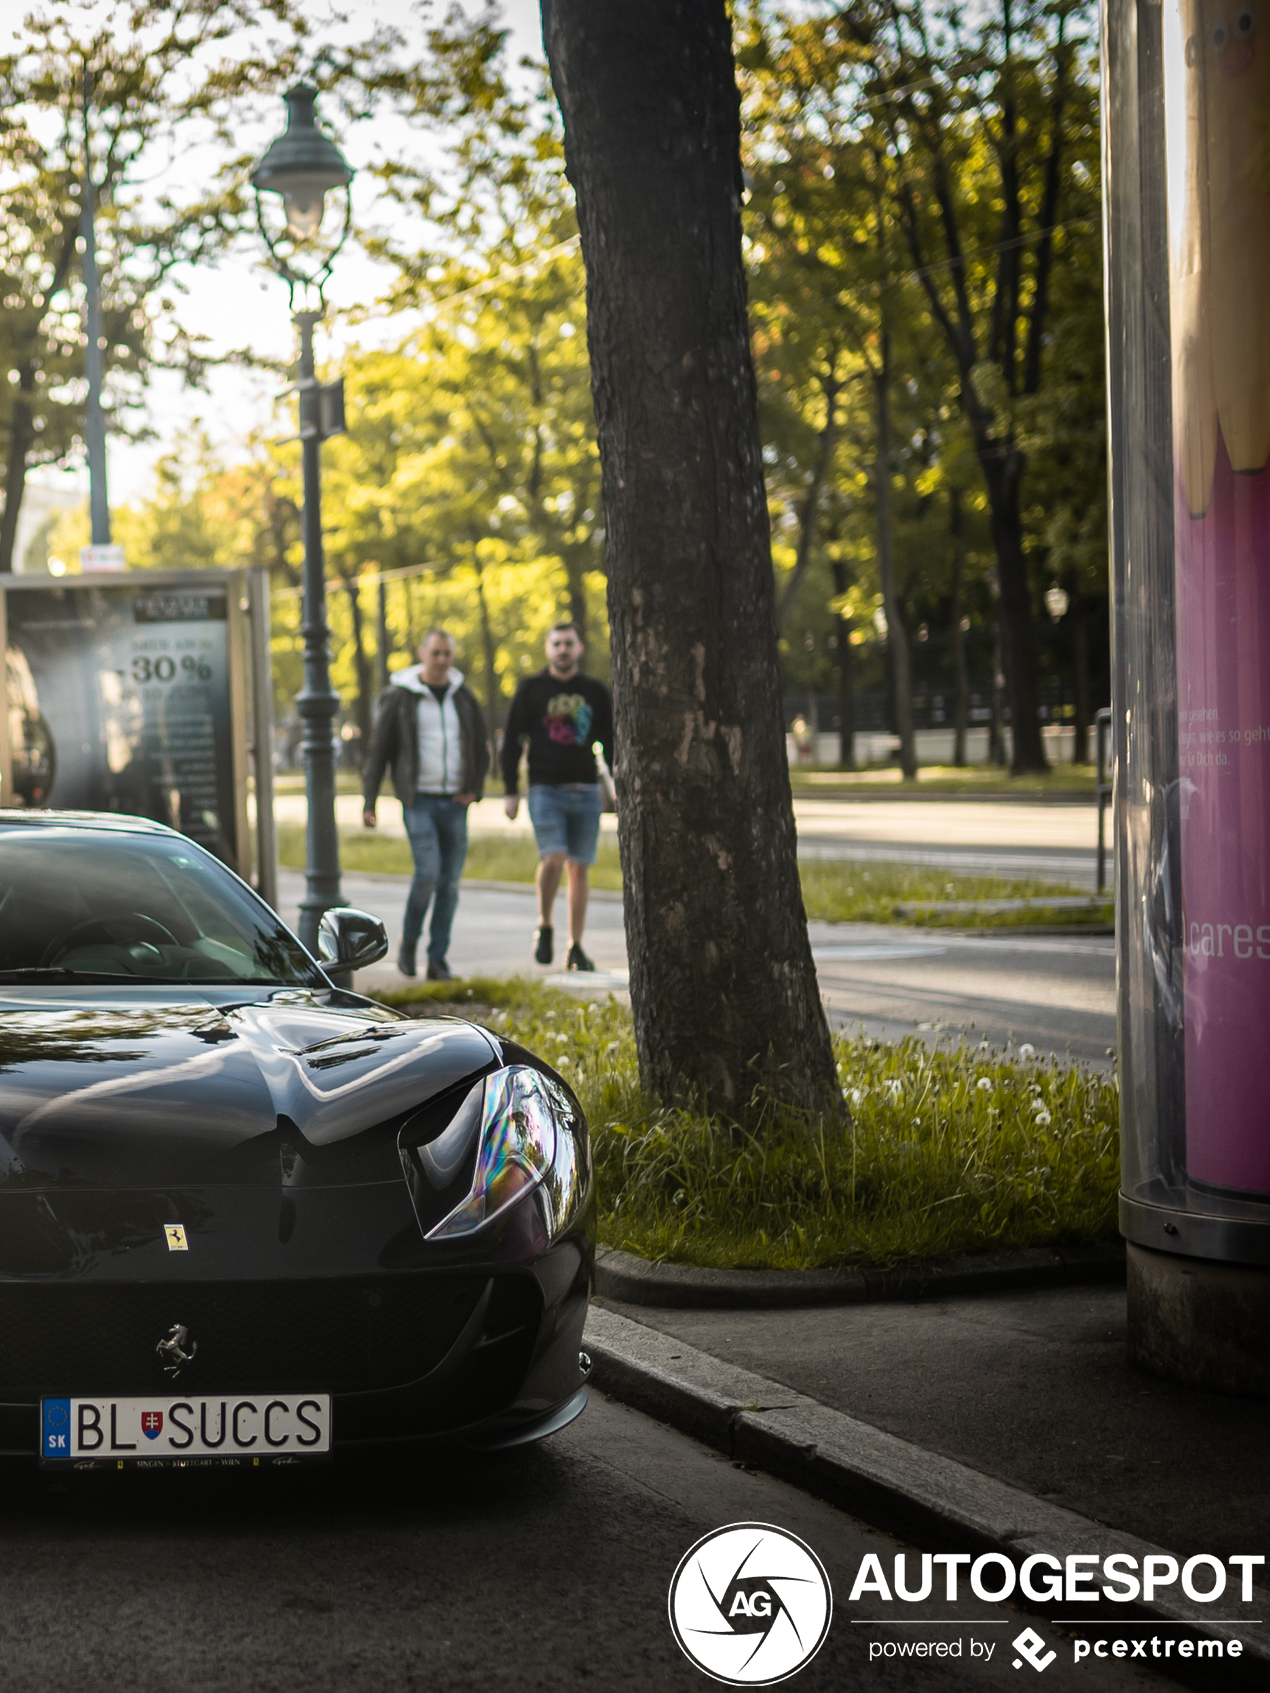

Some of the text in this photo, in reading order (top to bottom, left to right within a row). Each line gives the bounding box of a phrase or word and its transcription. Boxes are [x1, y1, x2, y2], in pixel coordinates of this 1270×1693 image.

[1215, 730, 1226, 742] es
[1228, 730, 1241, 742] so
[78, 1400, 321, 1450] BL SUCCS
[48, 1435, 66, 1448] SK
[136, 1460, 164, 1468] SINGEN
[172, 1459, 212, 1468] STUTTGART
[221, 1458, 241, 1466] WIEN
